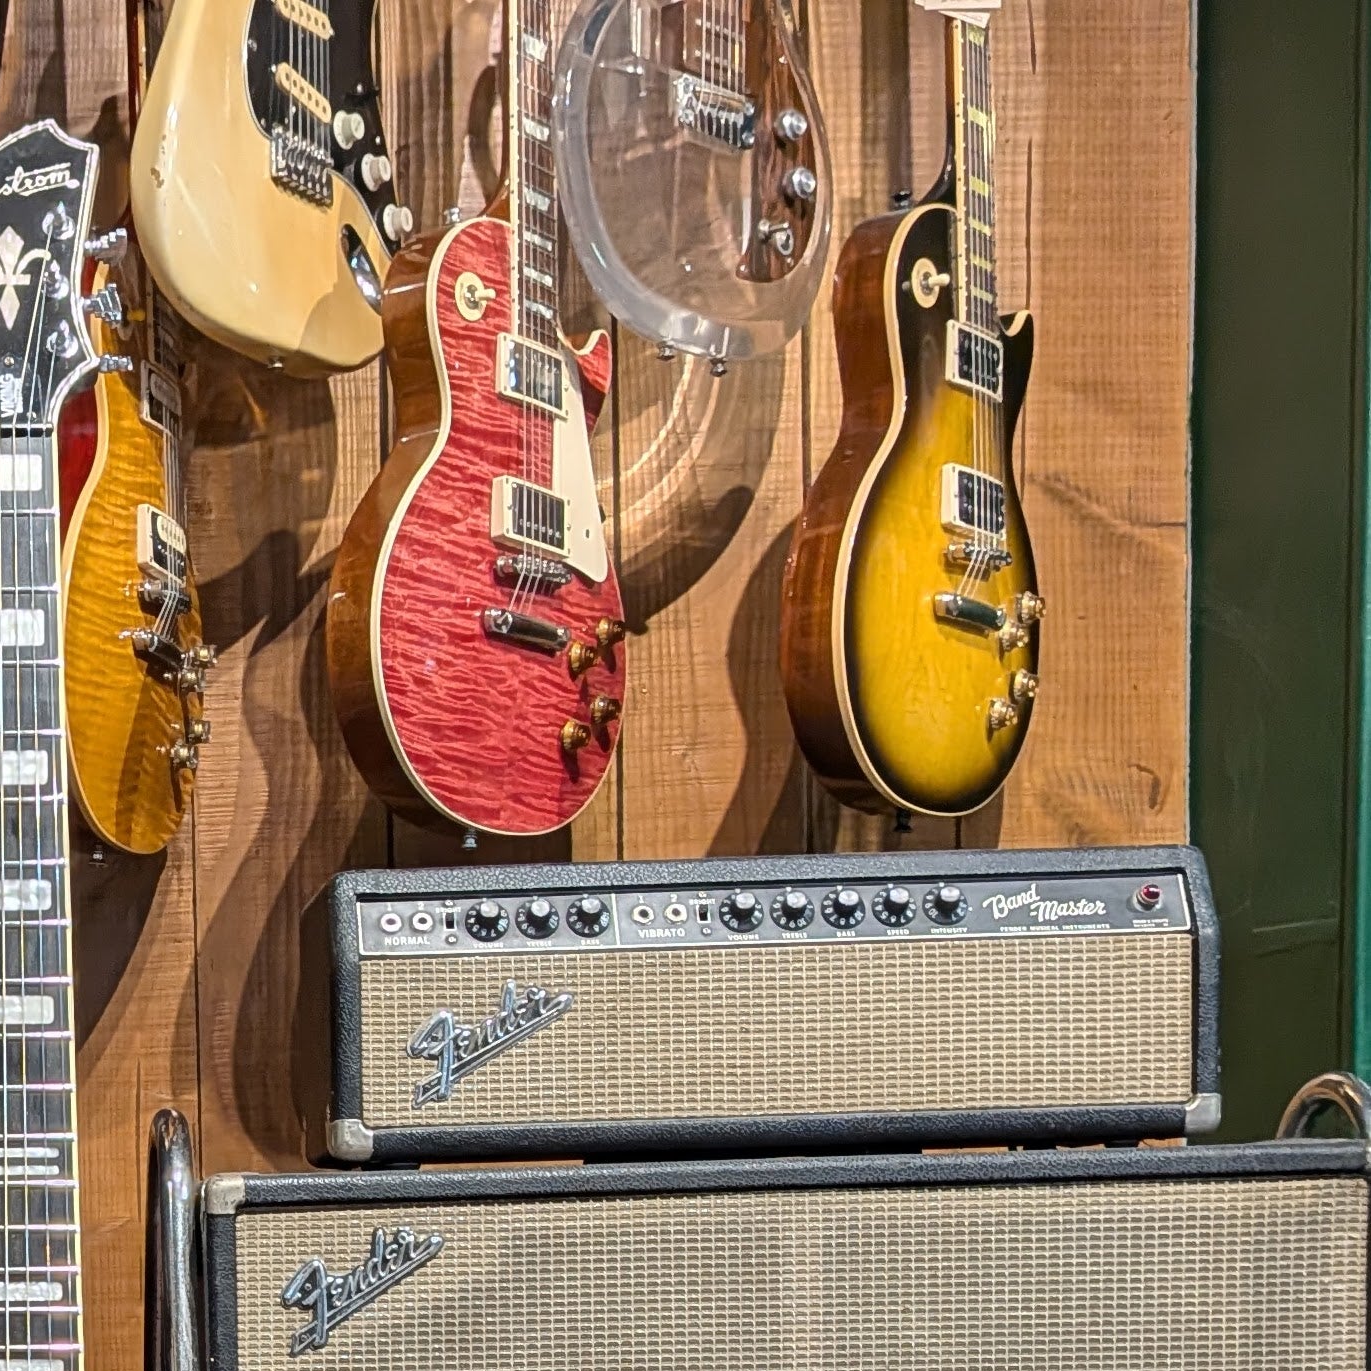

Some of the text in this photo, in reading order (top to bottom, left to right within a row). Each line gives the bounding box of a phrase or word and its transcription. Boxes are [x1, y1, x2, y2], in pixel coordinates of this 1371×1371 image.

[982, 883, 1040, 919] Band
[1030, 898, 1106, 922] Master
[384, 936, 431, 946] NORMAL
[637, 928, 686, 938] VIBRATO
[407, 979, 575, 1109] Fender
[282, 1226, 445, 1357] Fender
